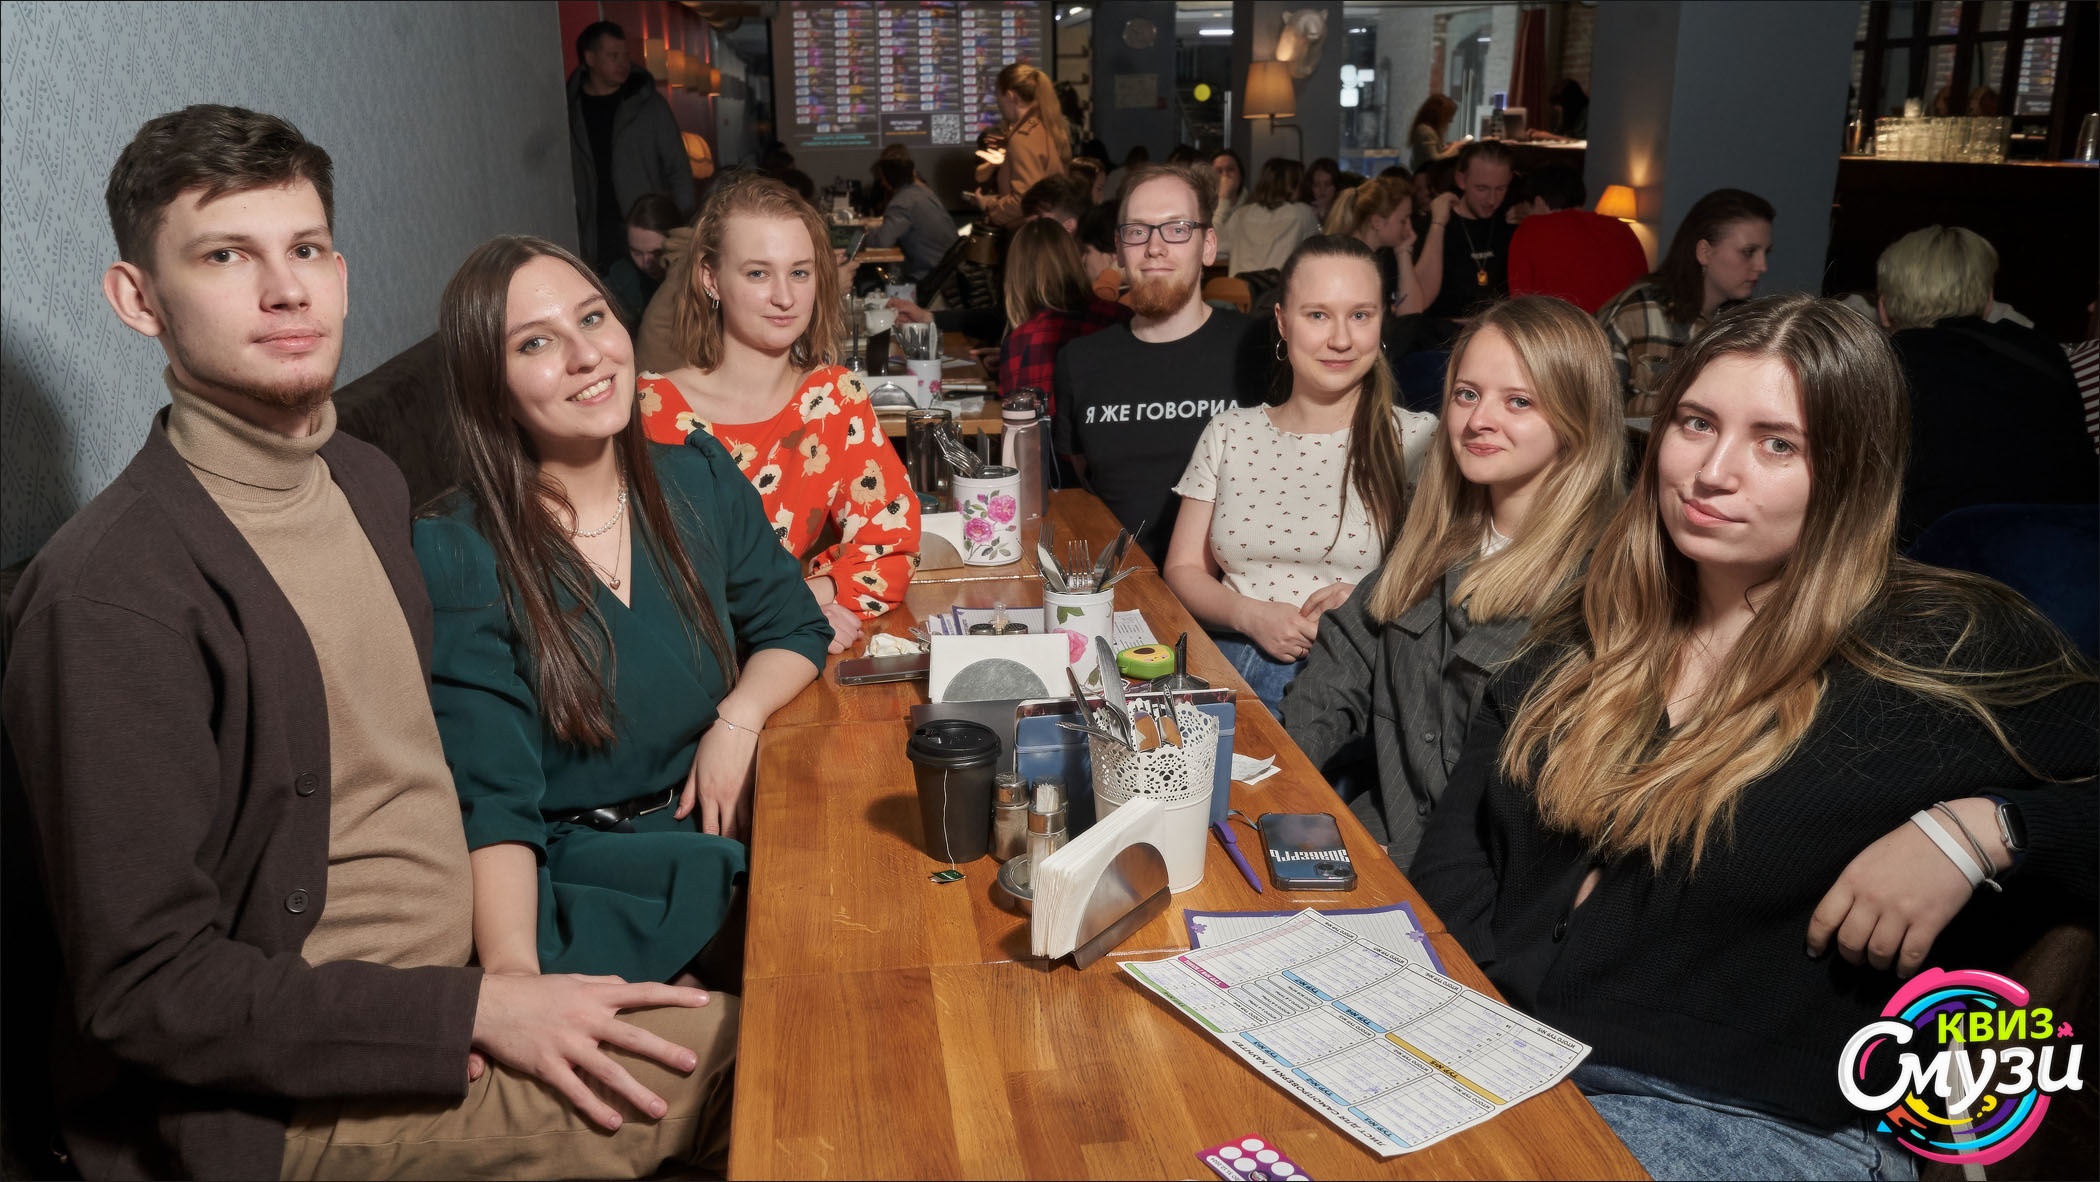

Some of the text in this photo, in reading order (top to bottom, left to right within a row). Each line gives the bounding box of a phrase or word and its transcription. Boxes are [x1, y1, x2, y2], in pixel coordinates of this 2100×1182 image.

[1085, 406, 1095, 424] Я
[1099, 404, 1131, 422] ЖЕ
[1305, 985, 1318, 993] ТУР
[1357, 1016, 1370, 1025] ТУР
[1546, 1032, 1556, 1040] ТУР
[1557, 1037, 1575, 1048] ИТОГО
[1231, 1040, 1268, 1065] КАУНТЕР
[1264, 1049, 1278, 1059] ТУР
[1443, 1068, 1458, 1079] ТУР
[1271, 1068, 1339, 1116] САМОПРОВЕРКИ
[1318, 1086, 1333, 1097] ТУР
[1338, 1115, 1361, 1128] ДЛЯ
[1376, 1126, 1392, 1137] ТУР
[1357, 1130, 1386, 1146] ЛИСТ
